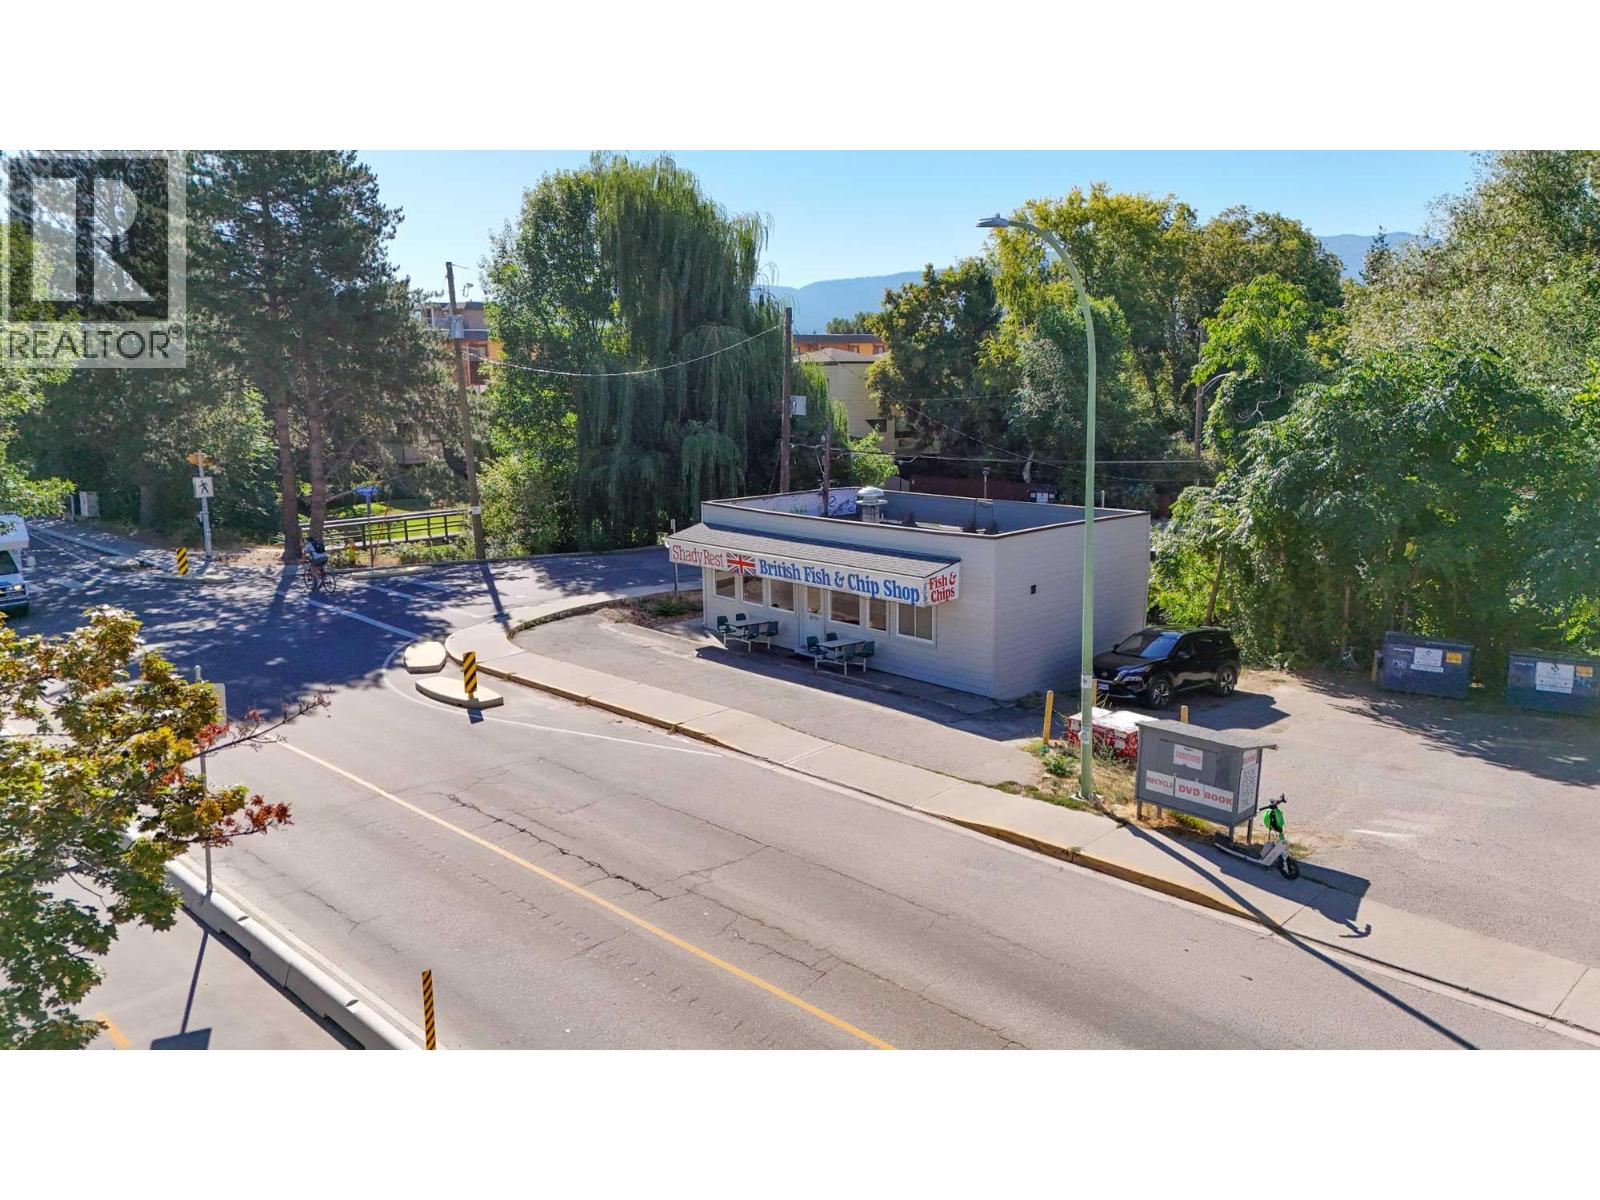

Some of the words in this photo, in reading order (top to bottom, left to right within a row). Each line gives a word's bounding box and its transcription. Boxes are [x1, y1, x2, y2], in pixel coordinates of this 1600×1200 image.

[672, 545, 703, 565] Shady
[703, 549, 725, 568] Rest
[759, 559, 801, 581] British
[803, 566, 831, 587] Fish
[835, 571, 845, 588] &
[847, 573, 880, 599] Chip
[884, 579, 920, 606] Shop
[929, 574, 948, 591] Fish
[949, 571, 957, 585] &
[931, 586, 955, 603] Chips
[1178, 784, 1200, 797] DVD
[1204, 791, 1232, 806] BOOK
